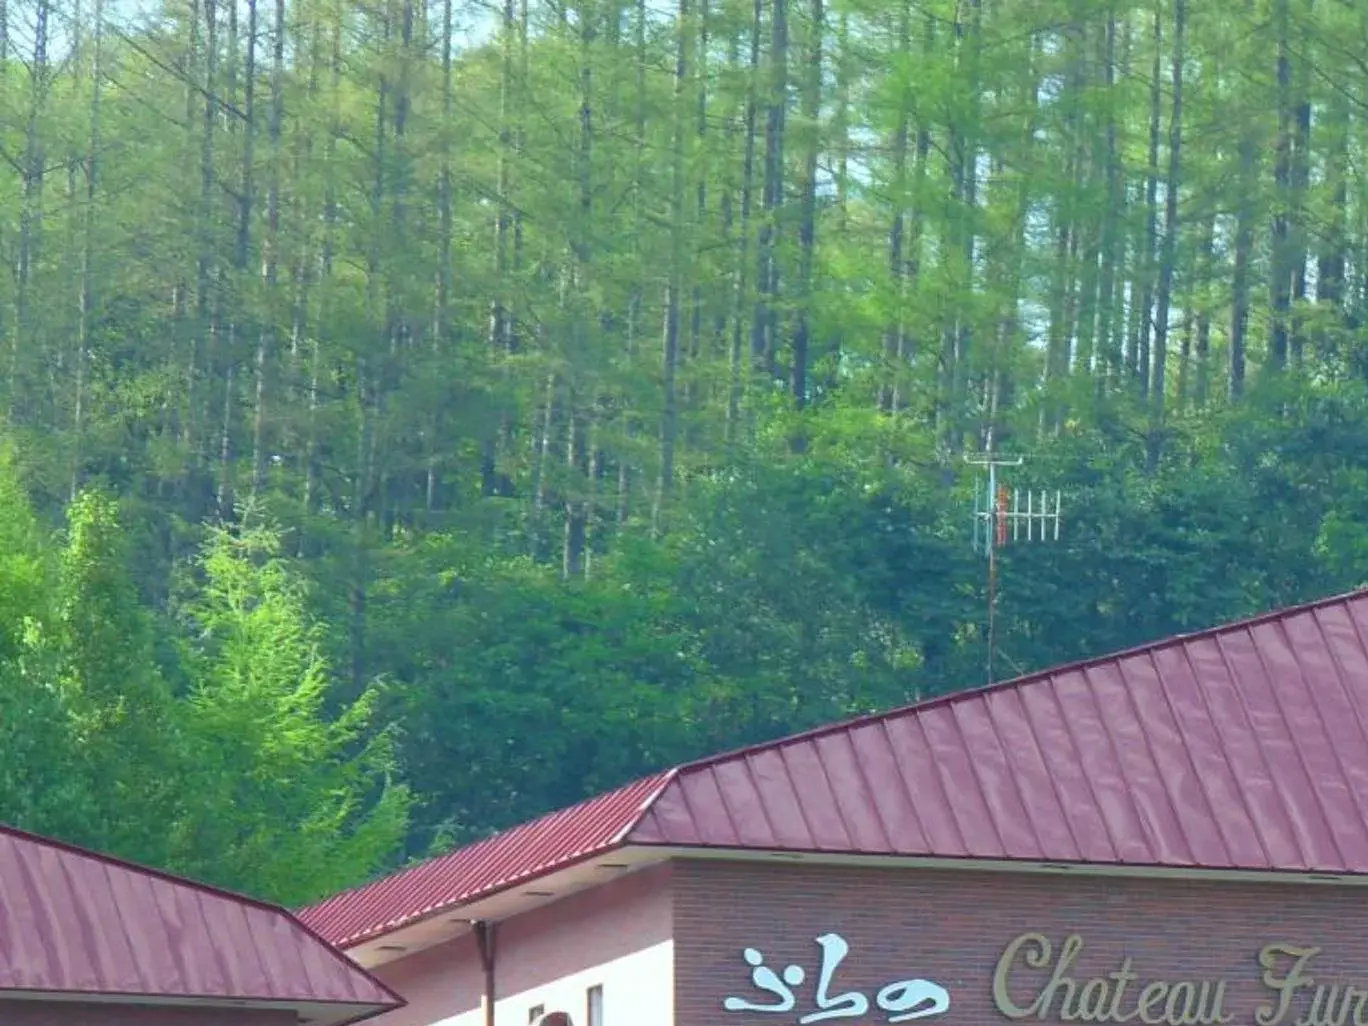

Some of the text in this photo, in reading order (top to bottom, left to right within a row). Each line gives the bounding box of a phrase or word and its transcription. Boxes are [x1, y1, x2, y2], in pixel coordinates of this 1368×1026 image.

[724, 933, 950, 1024] ふらの
[992, 932, 1235, 1026] Chateau
